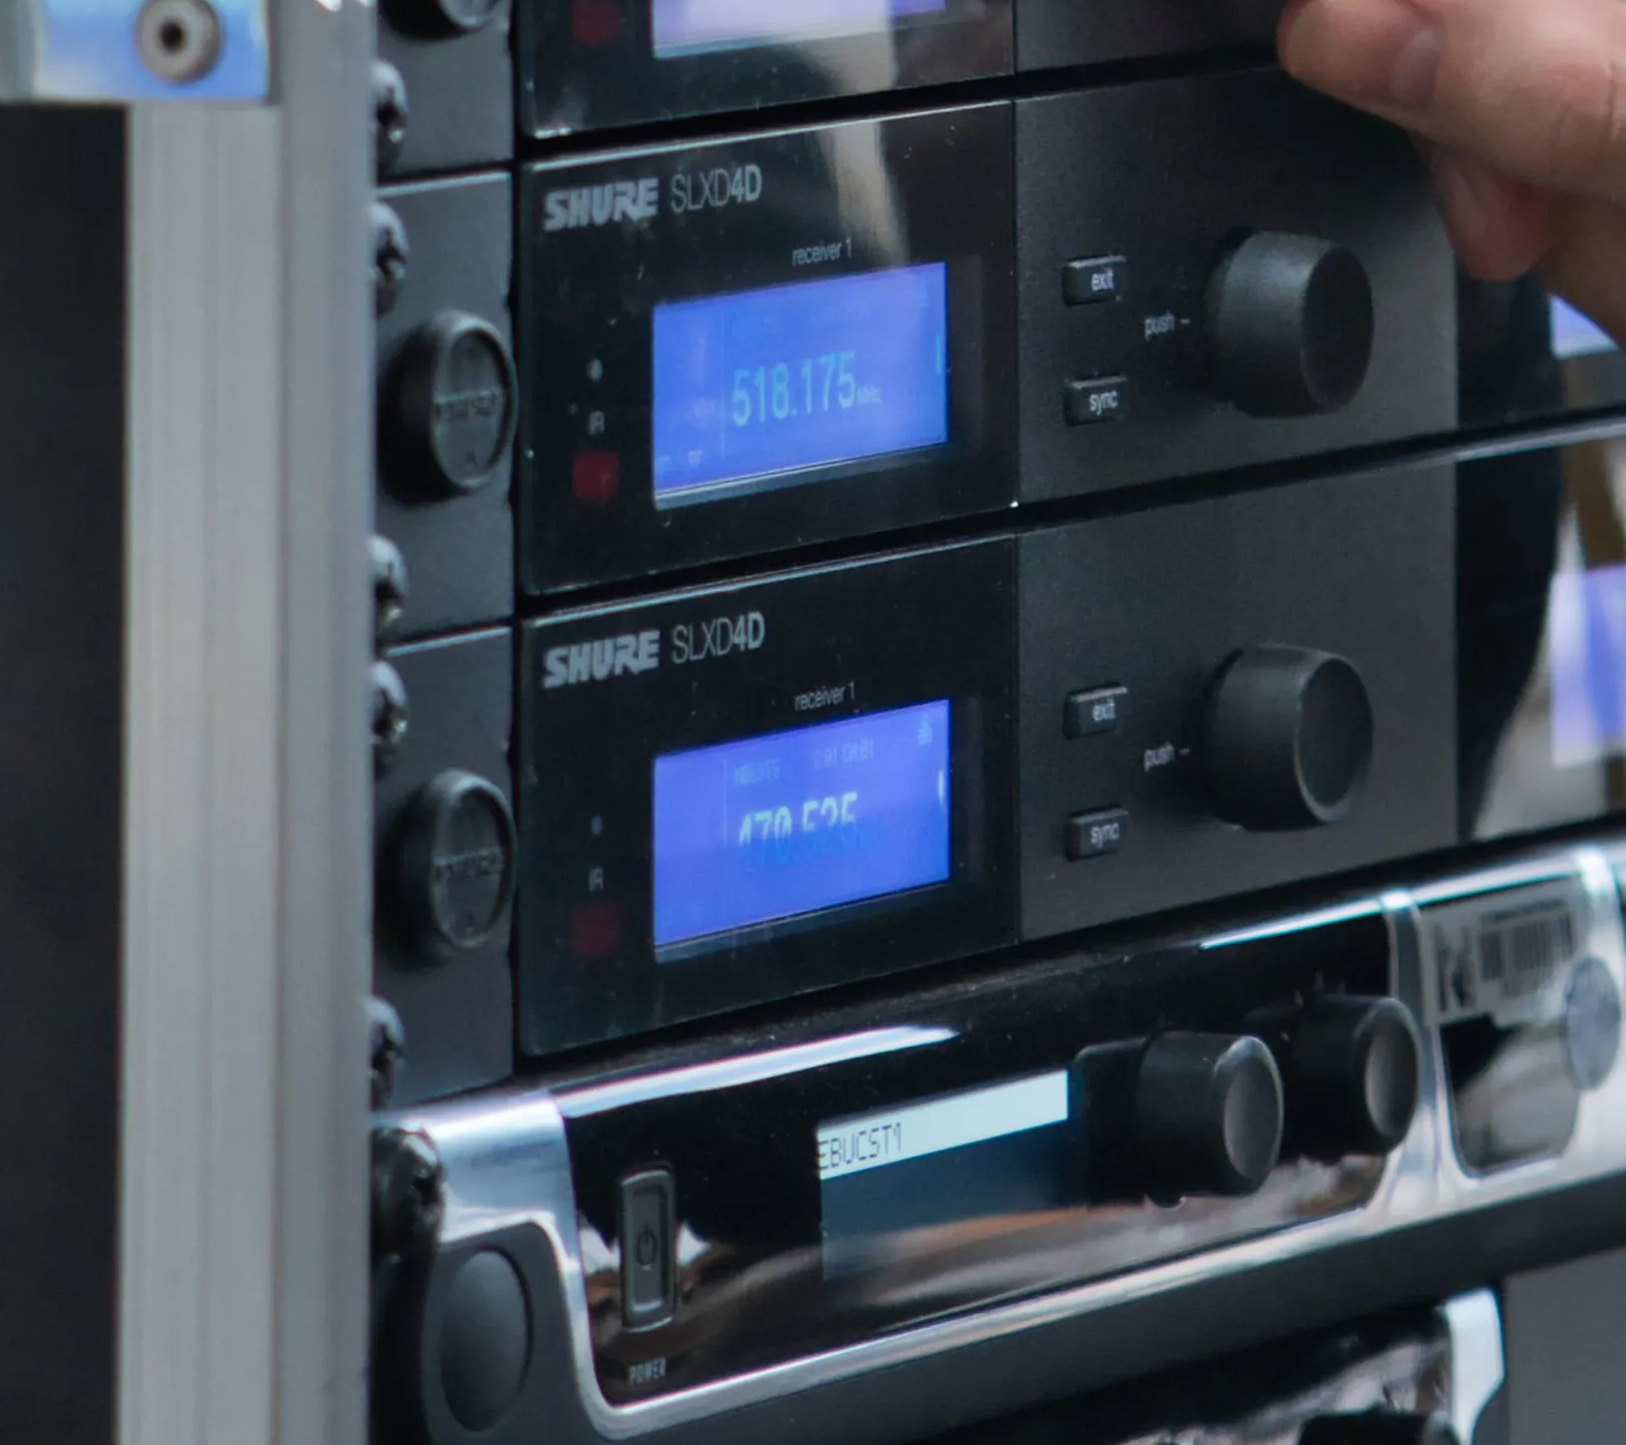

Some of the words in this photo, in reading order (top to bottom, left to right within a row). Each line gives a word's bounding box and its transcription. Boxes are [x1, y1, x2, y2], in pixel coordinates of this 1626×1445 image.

[543, 177, 659, 232] SHURE
[670, 164, 762, 213] SLXD4D
[792, 241, 842, 267] receiver
[1091, 267, 1115, 291] exit
[732, 350, 855, 427] 518.175
[1089, 390, 1118, 416] sync
[542, 630, 661, 689] SHURE
[671, 611, 765, 664] SLXD4D
[794, 685, 845, 712] receiver
[848, 680, 855, 701] 1
[1090, 822, 1120, 849] sync
[628, 1357, 667, 1385] POWER
